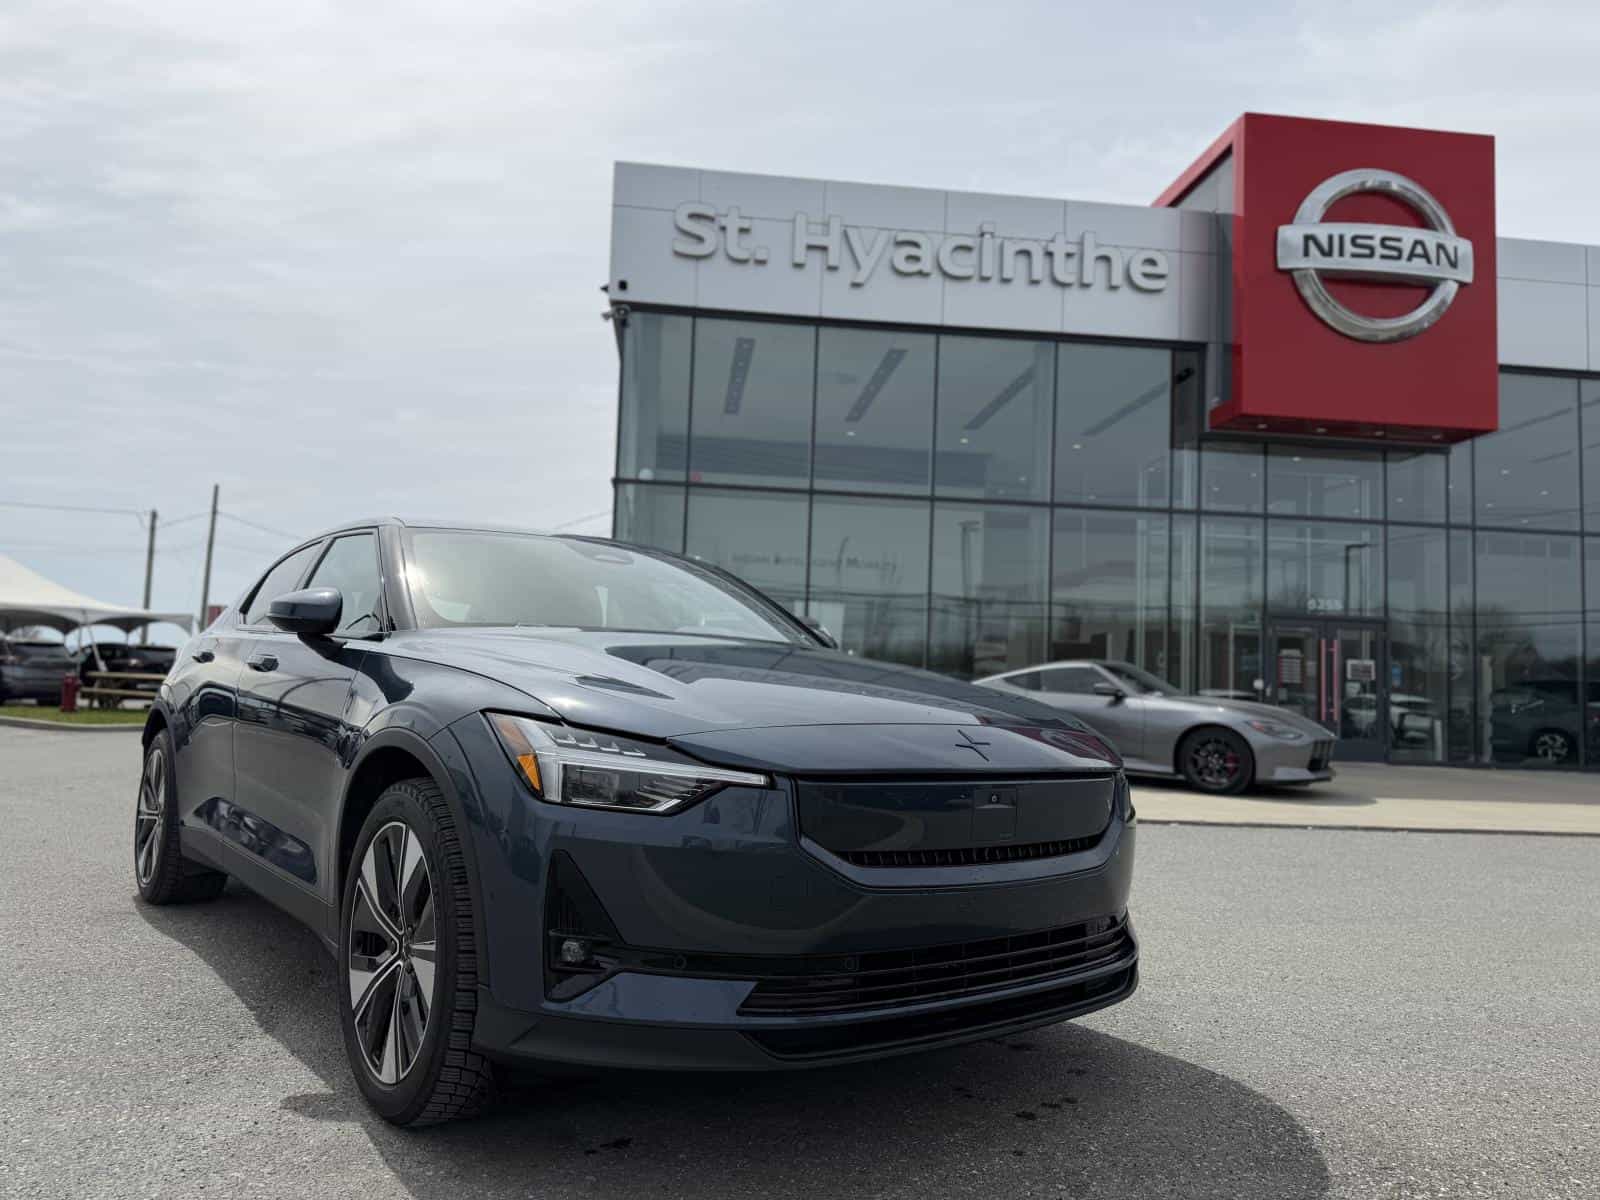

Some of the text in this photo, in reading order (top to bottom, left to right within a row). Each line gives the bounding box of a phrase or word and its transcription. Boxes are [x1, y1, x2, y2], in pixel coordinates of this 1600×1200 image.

[672, 201, 1169, 295] St. Hyacinthe
[1302, 233, 1459, 270] NISSAN
